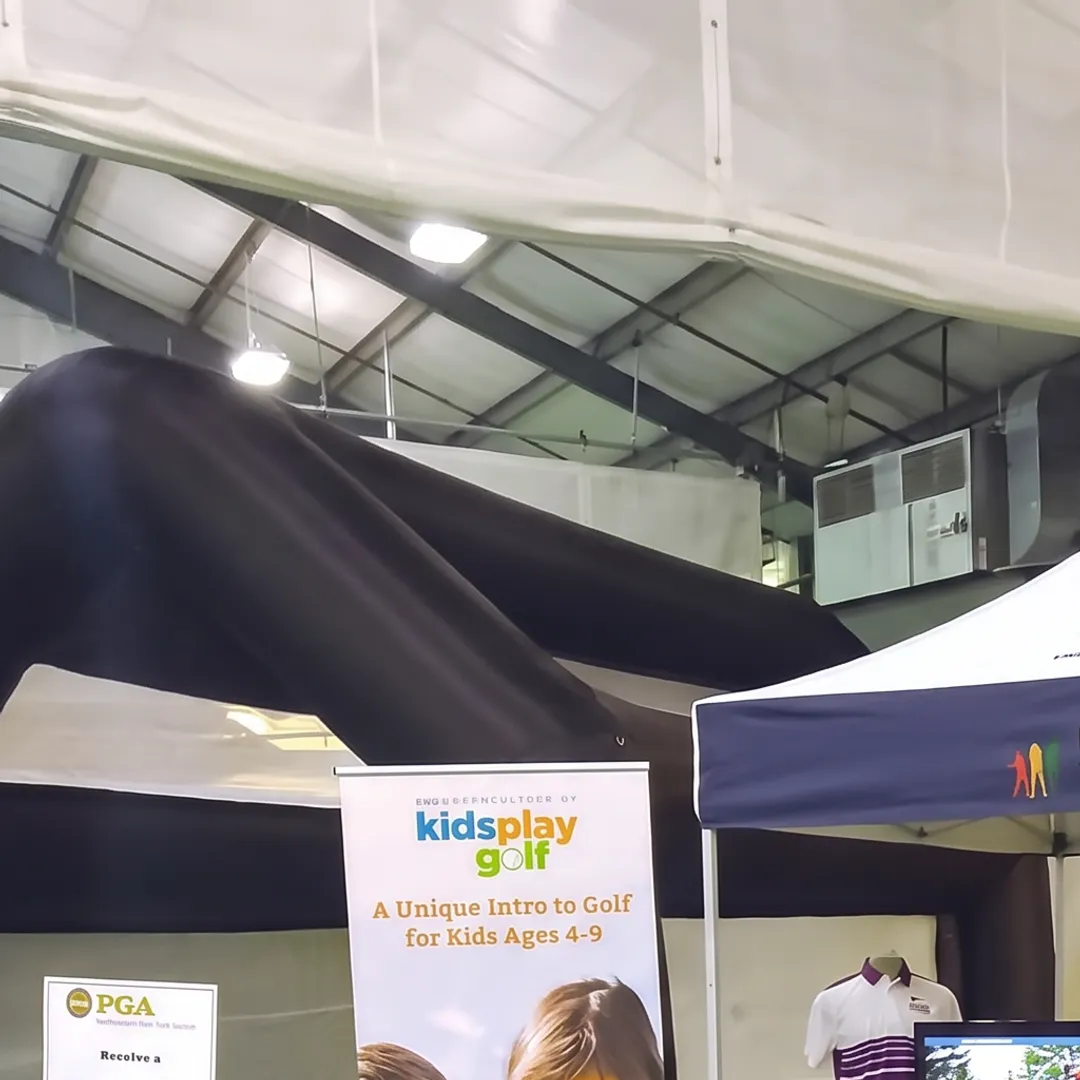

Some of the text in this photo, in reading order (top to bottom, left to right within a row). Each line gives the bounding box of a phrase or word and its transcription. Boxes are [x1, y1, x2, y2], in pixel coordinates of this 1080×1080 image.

[415, 809, 578, 846] kidsplay
[475, 840, 551, 878] golf
[372, 894, 634, 922] A Unique Intro to Golf
[405, 925, 603, 950] for Kids Ages 4-9
[96, 994, 156, 1017] PGA
[153, 1055, 162, 1063] a
